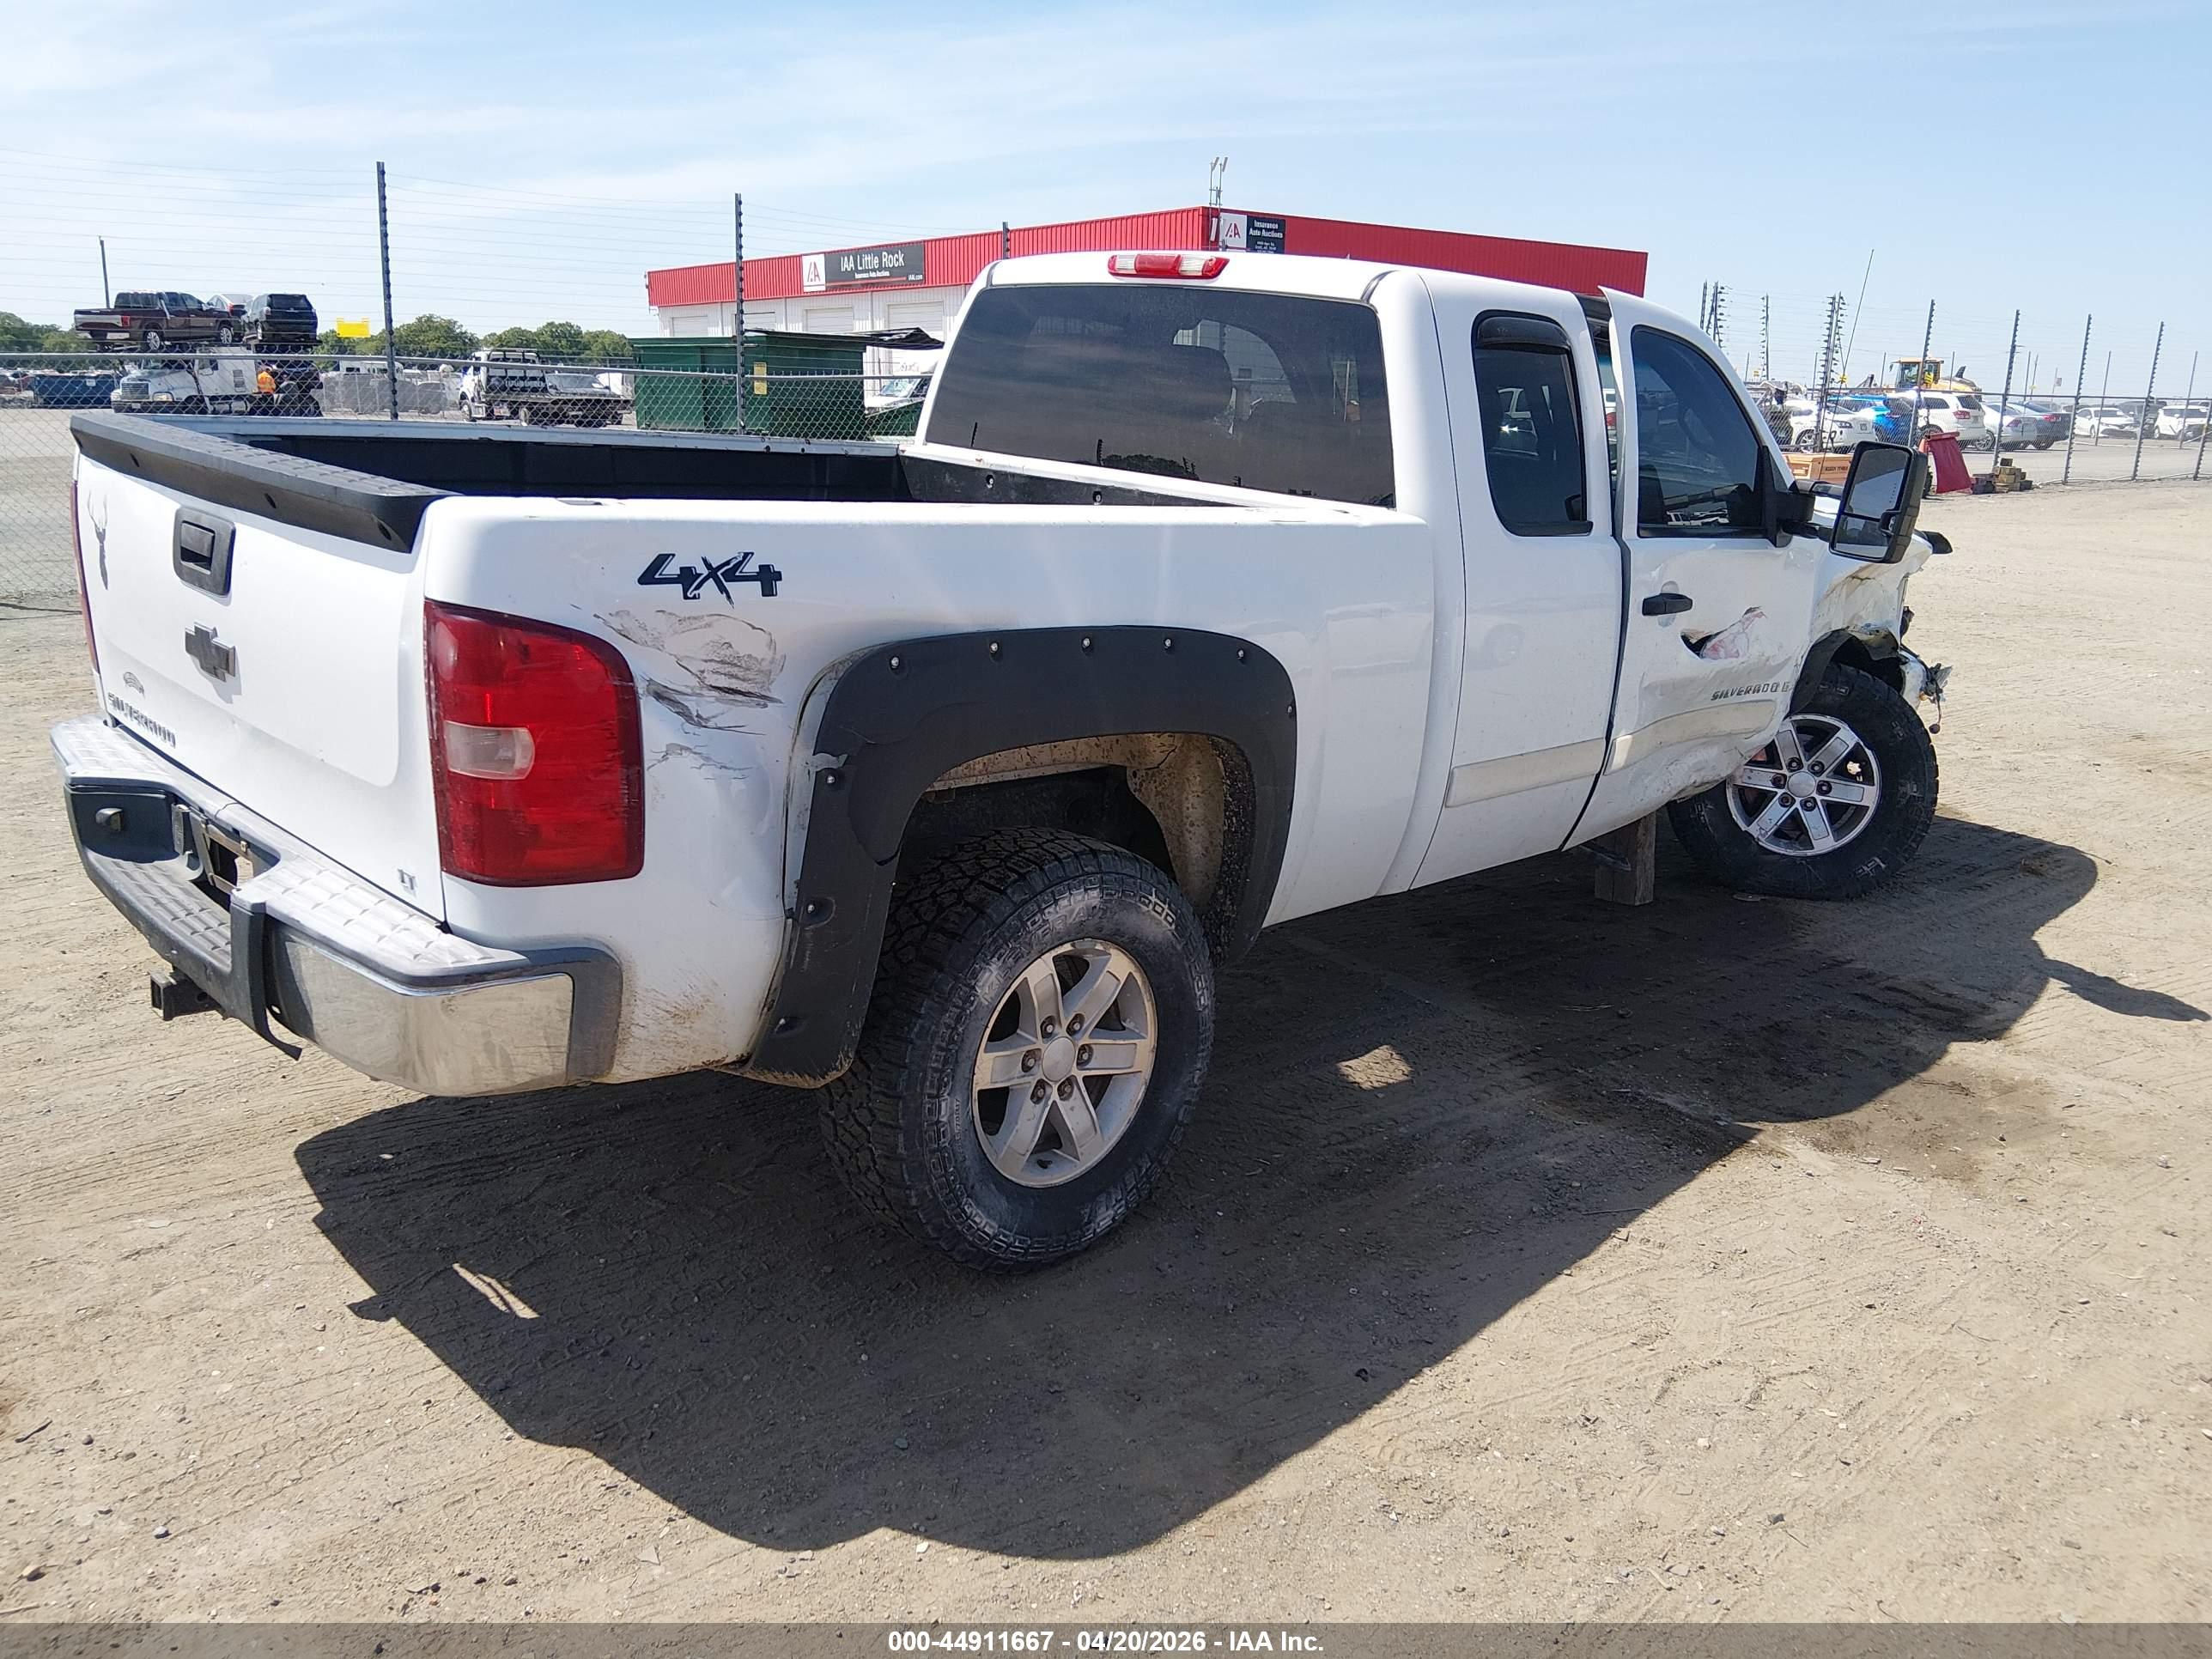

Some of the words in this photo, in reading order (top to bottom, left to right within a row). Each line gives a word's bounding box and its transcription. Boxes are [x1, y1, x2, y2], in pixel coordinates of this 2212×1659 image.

[1249, 227, 1261, 236] Auto
[1261, 228, 1284, 239] Auctions
[841, 254, 854, 272] IAA
[857, 252, 879, 270] Little
[882, 249, 905, 268] Rock
[1711, 682, 1779, 702] SILVERADO
